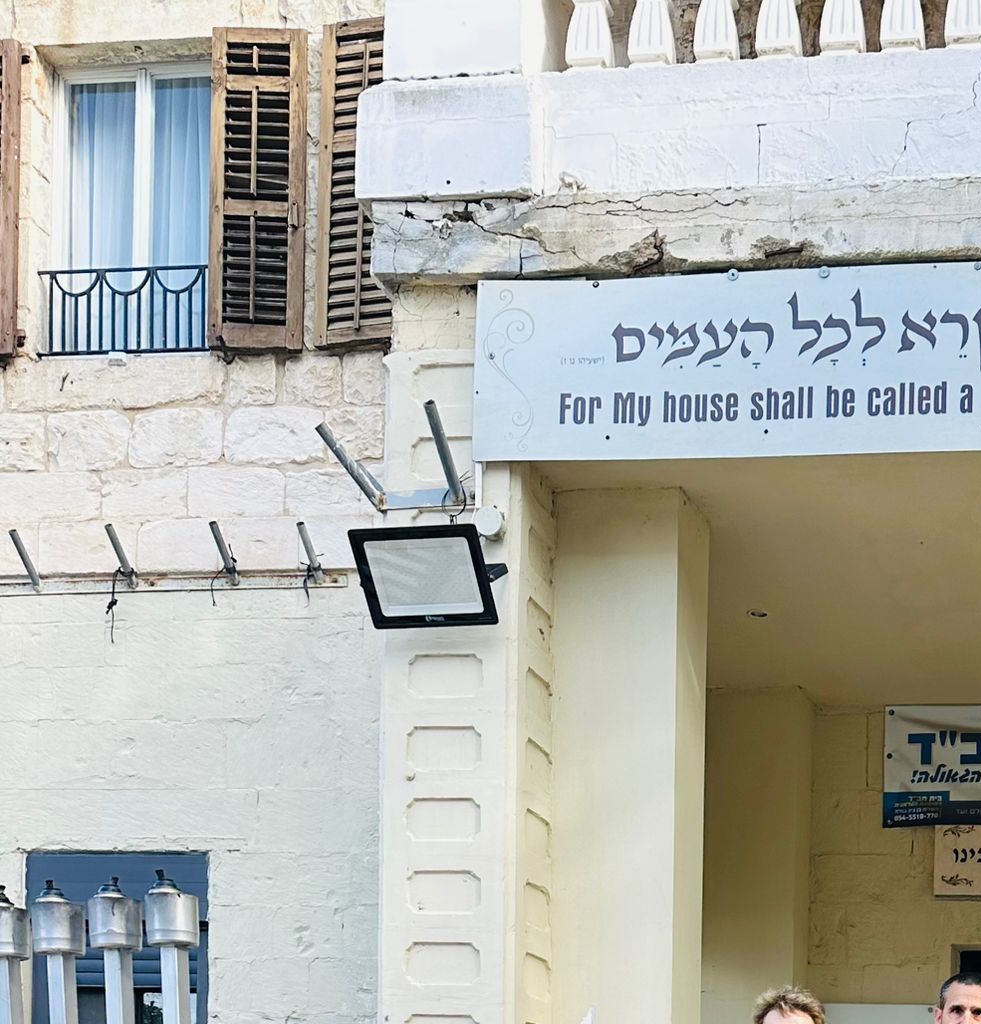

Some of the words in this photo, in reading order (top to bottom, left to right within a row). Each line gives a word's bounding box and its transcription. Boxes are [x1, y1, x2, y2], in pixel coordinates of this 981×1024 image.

[558, 392, 603, 425] For
[612, 391, 651, 427] My
[662, 391, 740, 423] house
[750, 386, 814, 422] shall
[825, 384, 856, 418] be
[867, 381, 948, 416] called
[959, 383, 974, 414] a
